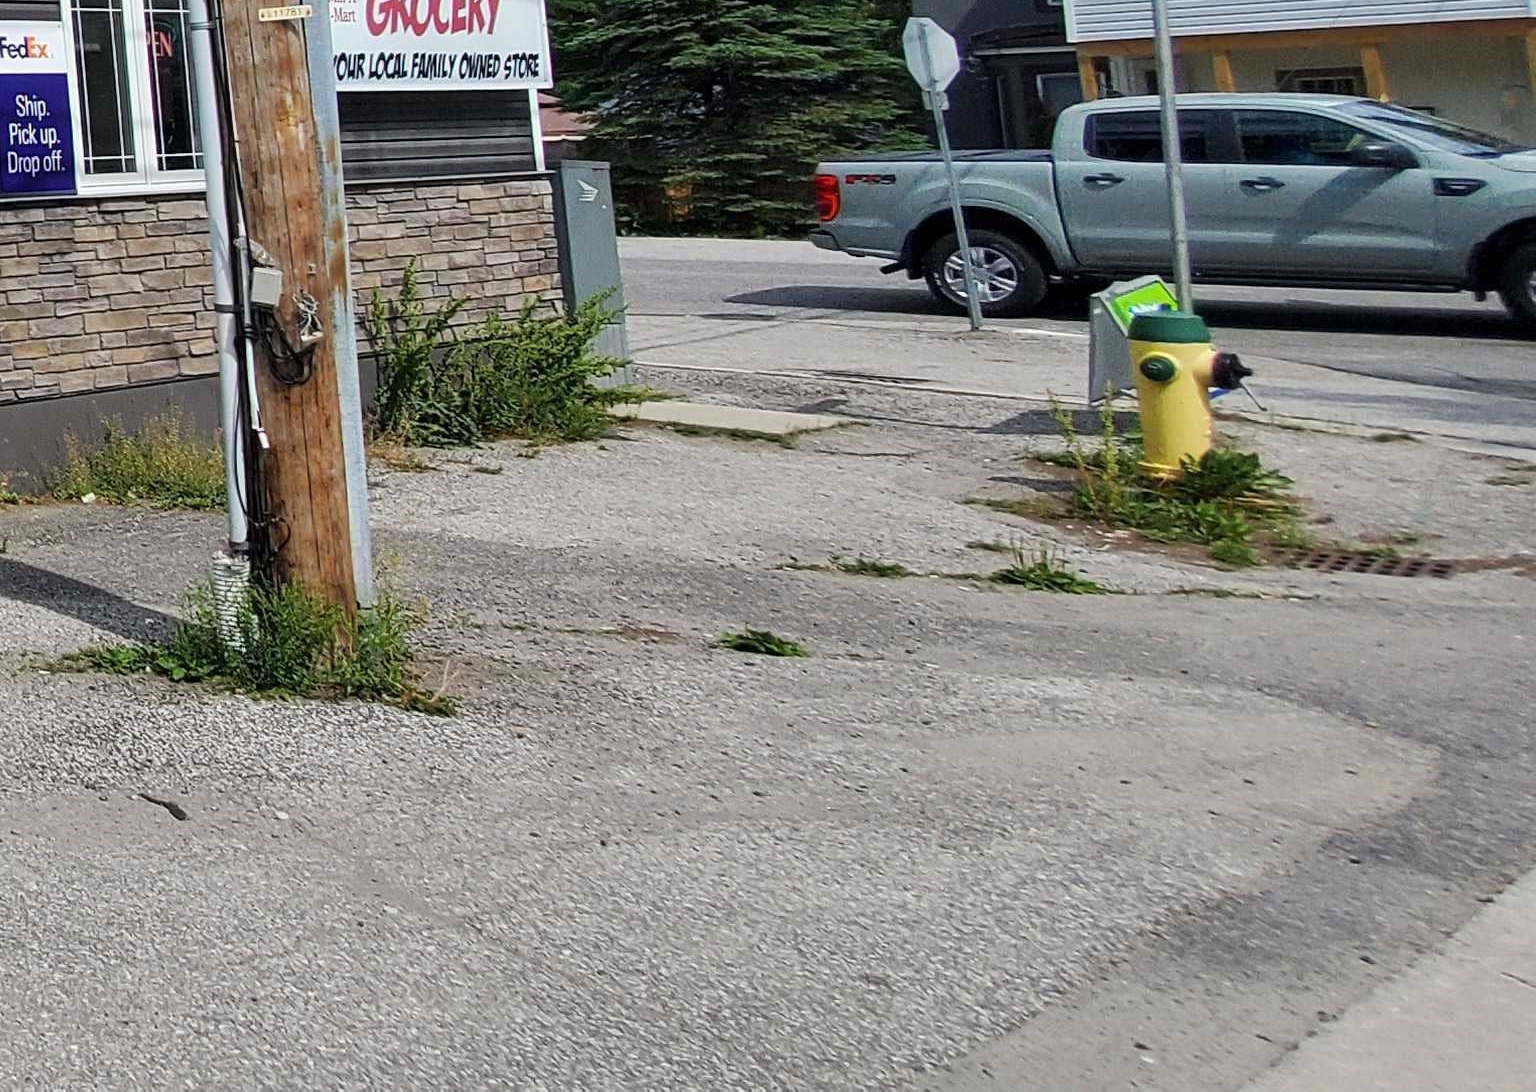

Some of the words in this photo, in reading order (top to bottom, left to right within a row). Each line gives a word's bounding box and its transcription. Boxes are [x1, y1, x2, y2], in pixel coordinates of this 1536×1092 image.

[333, 52, 365, 81] OUR
[369, 52, 408, 80] LOCAL
[411, 51, 455, 79] FAMILY
[459, 52, 501, 79] OWNED
[504, 52, 540, 80] STORE
[16, 94, 50, 121] Ship.
[9, 123, 37, 146] Pick
[40, 129, 60, 149] up.
[7, 151, 41, 178] Drop
[43, 150, 66, 172] off.
